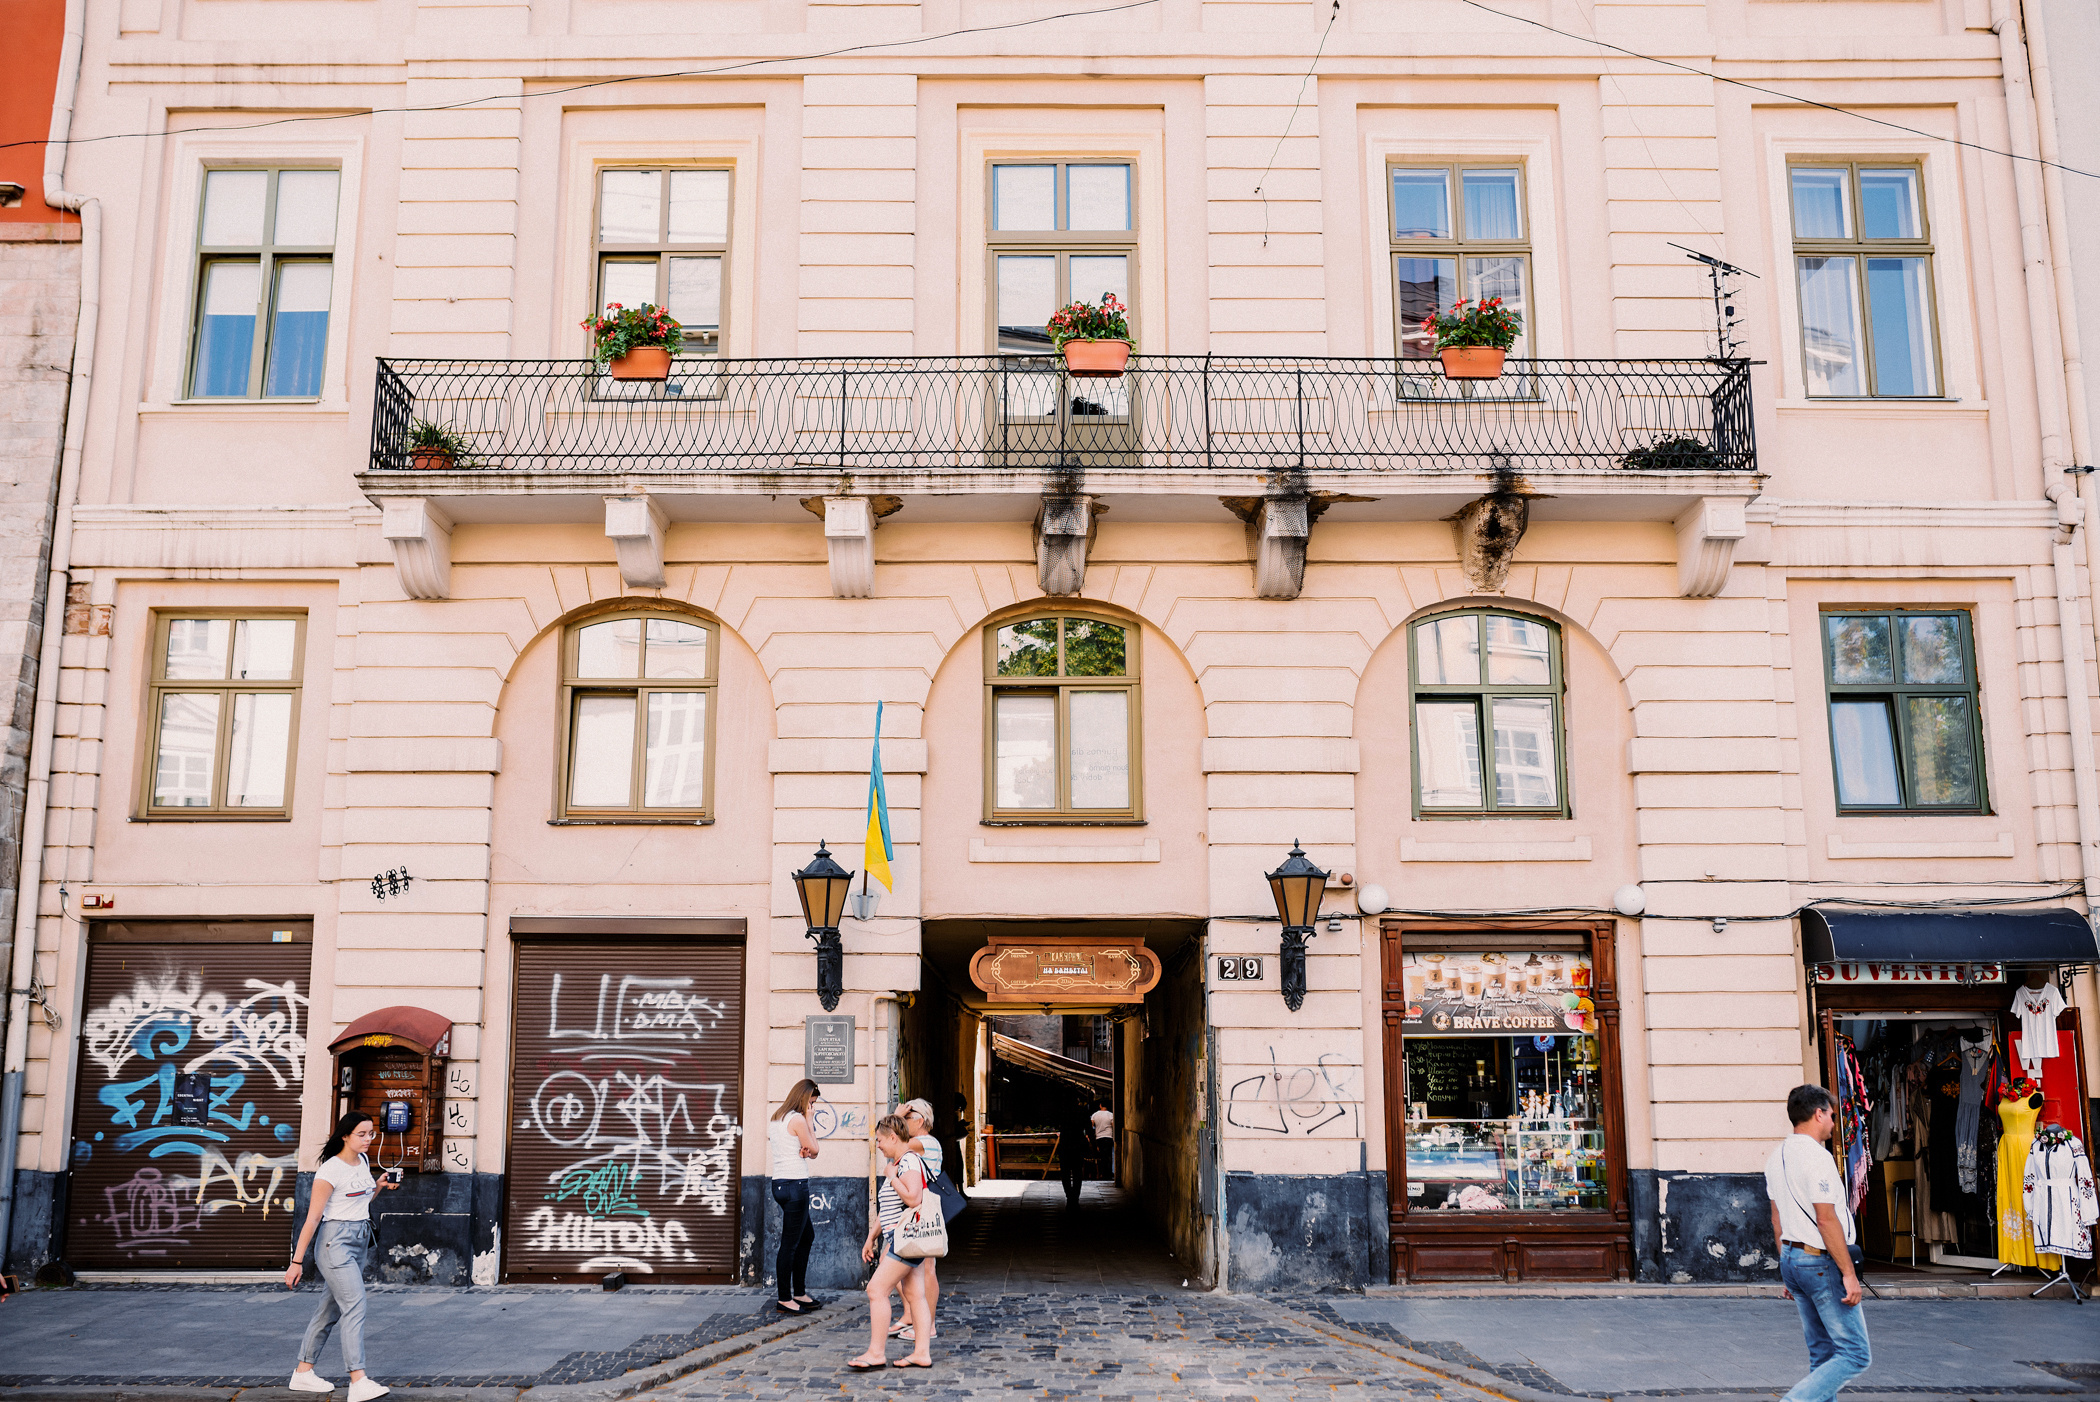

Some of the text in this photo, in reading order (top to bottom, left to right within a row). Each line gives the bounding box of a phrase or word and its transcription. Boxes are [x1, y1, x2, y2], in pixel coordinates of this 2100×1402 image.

[1223, 959, 1258, 978] 29
[1453, 1015, 1556, 1030] BRAVE COFFEE
